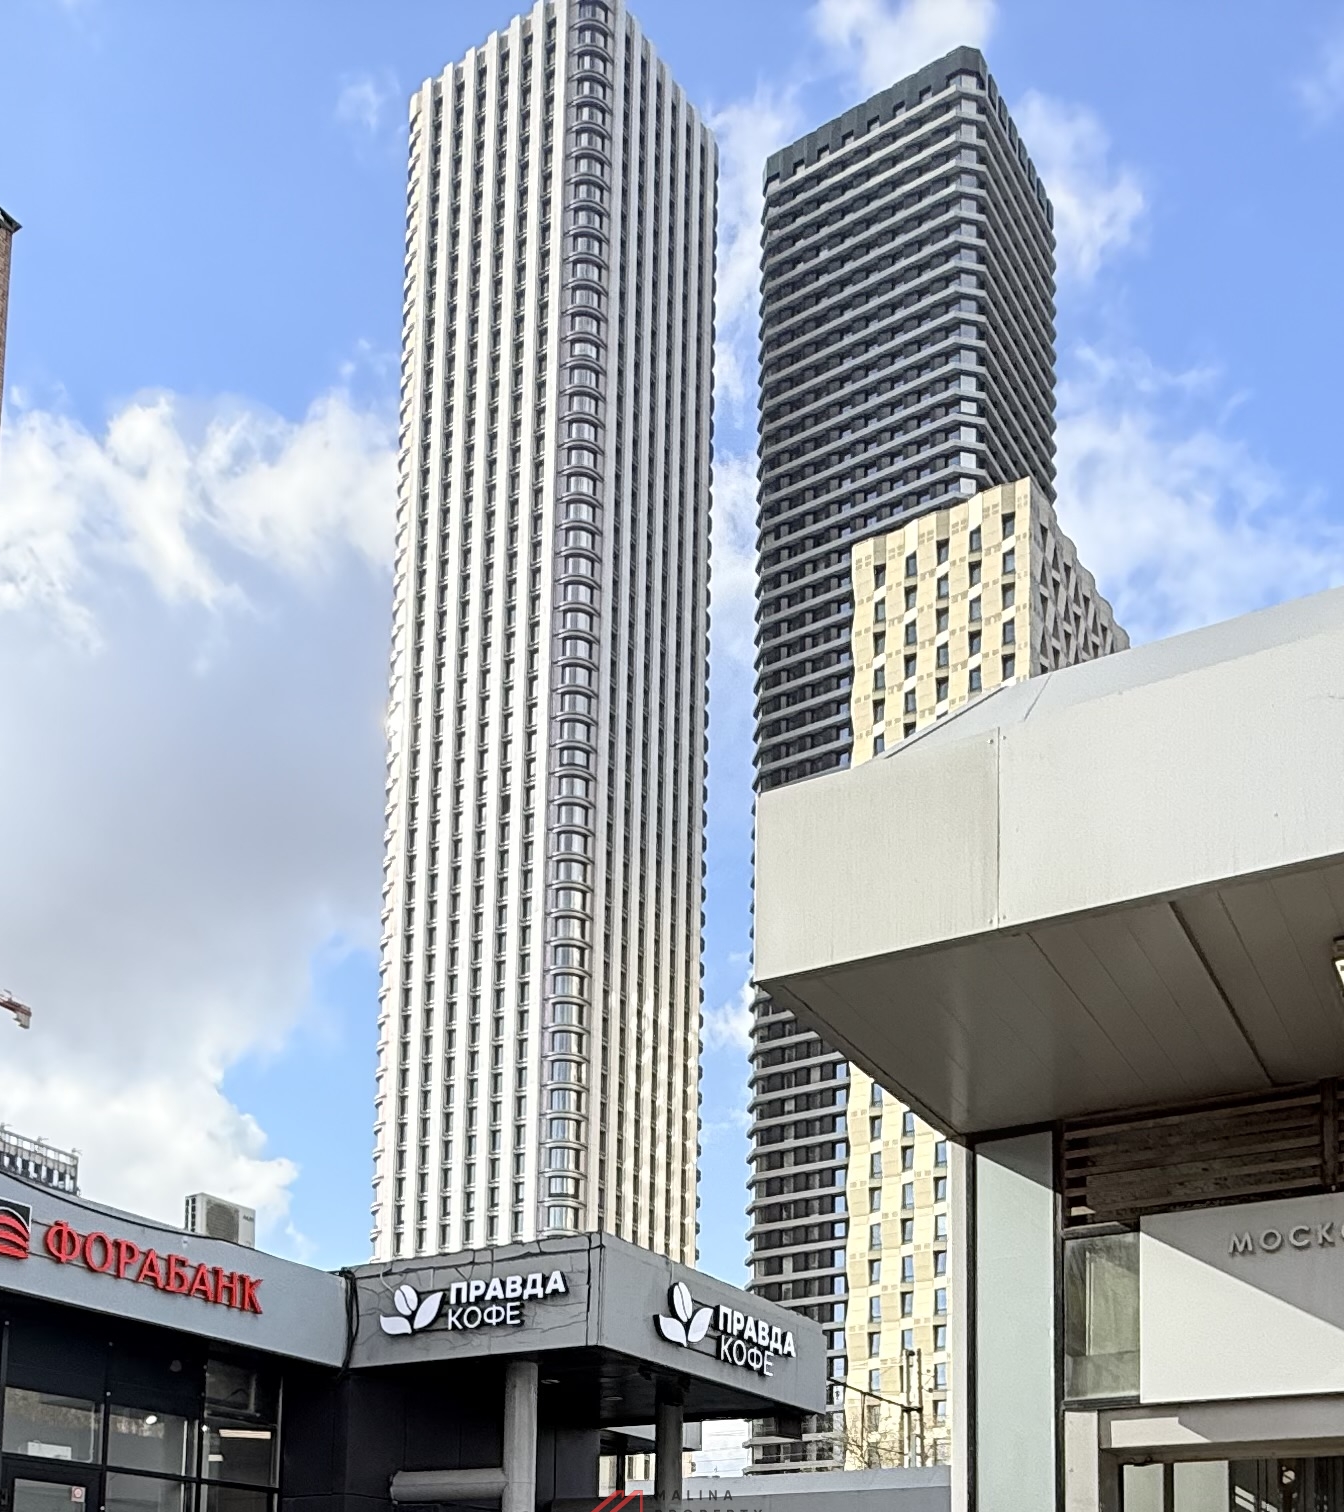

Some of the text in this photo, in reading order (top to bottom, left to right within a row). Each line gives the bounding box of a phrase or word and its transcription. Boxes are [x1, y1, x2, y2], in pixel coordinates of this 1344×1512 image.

[45, 1219, 264, 1315] ФОРАБАНК
[450, 1270, 566, 1305] ПРАВДА
[447, 1301, 521, 1331] КОФЕ
[719, 1304, 796, 1358] ПРАВДА
[721, 1334, 775, 1377] КОФЕ
